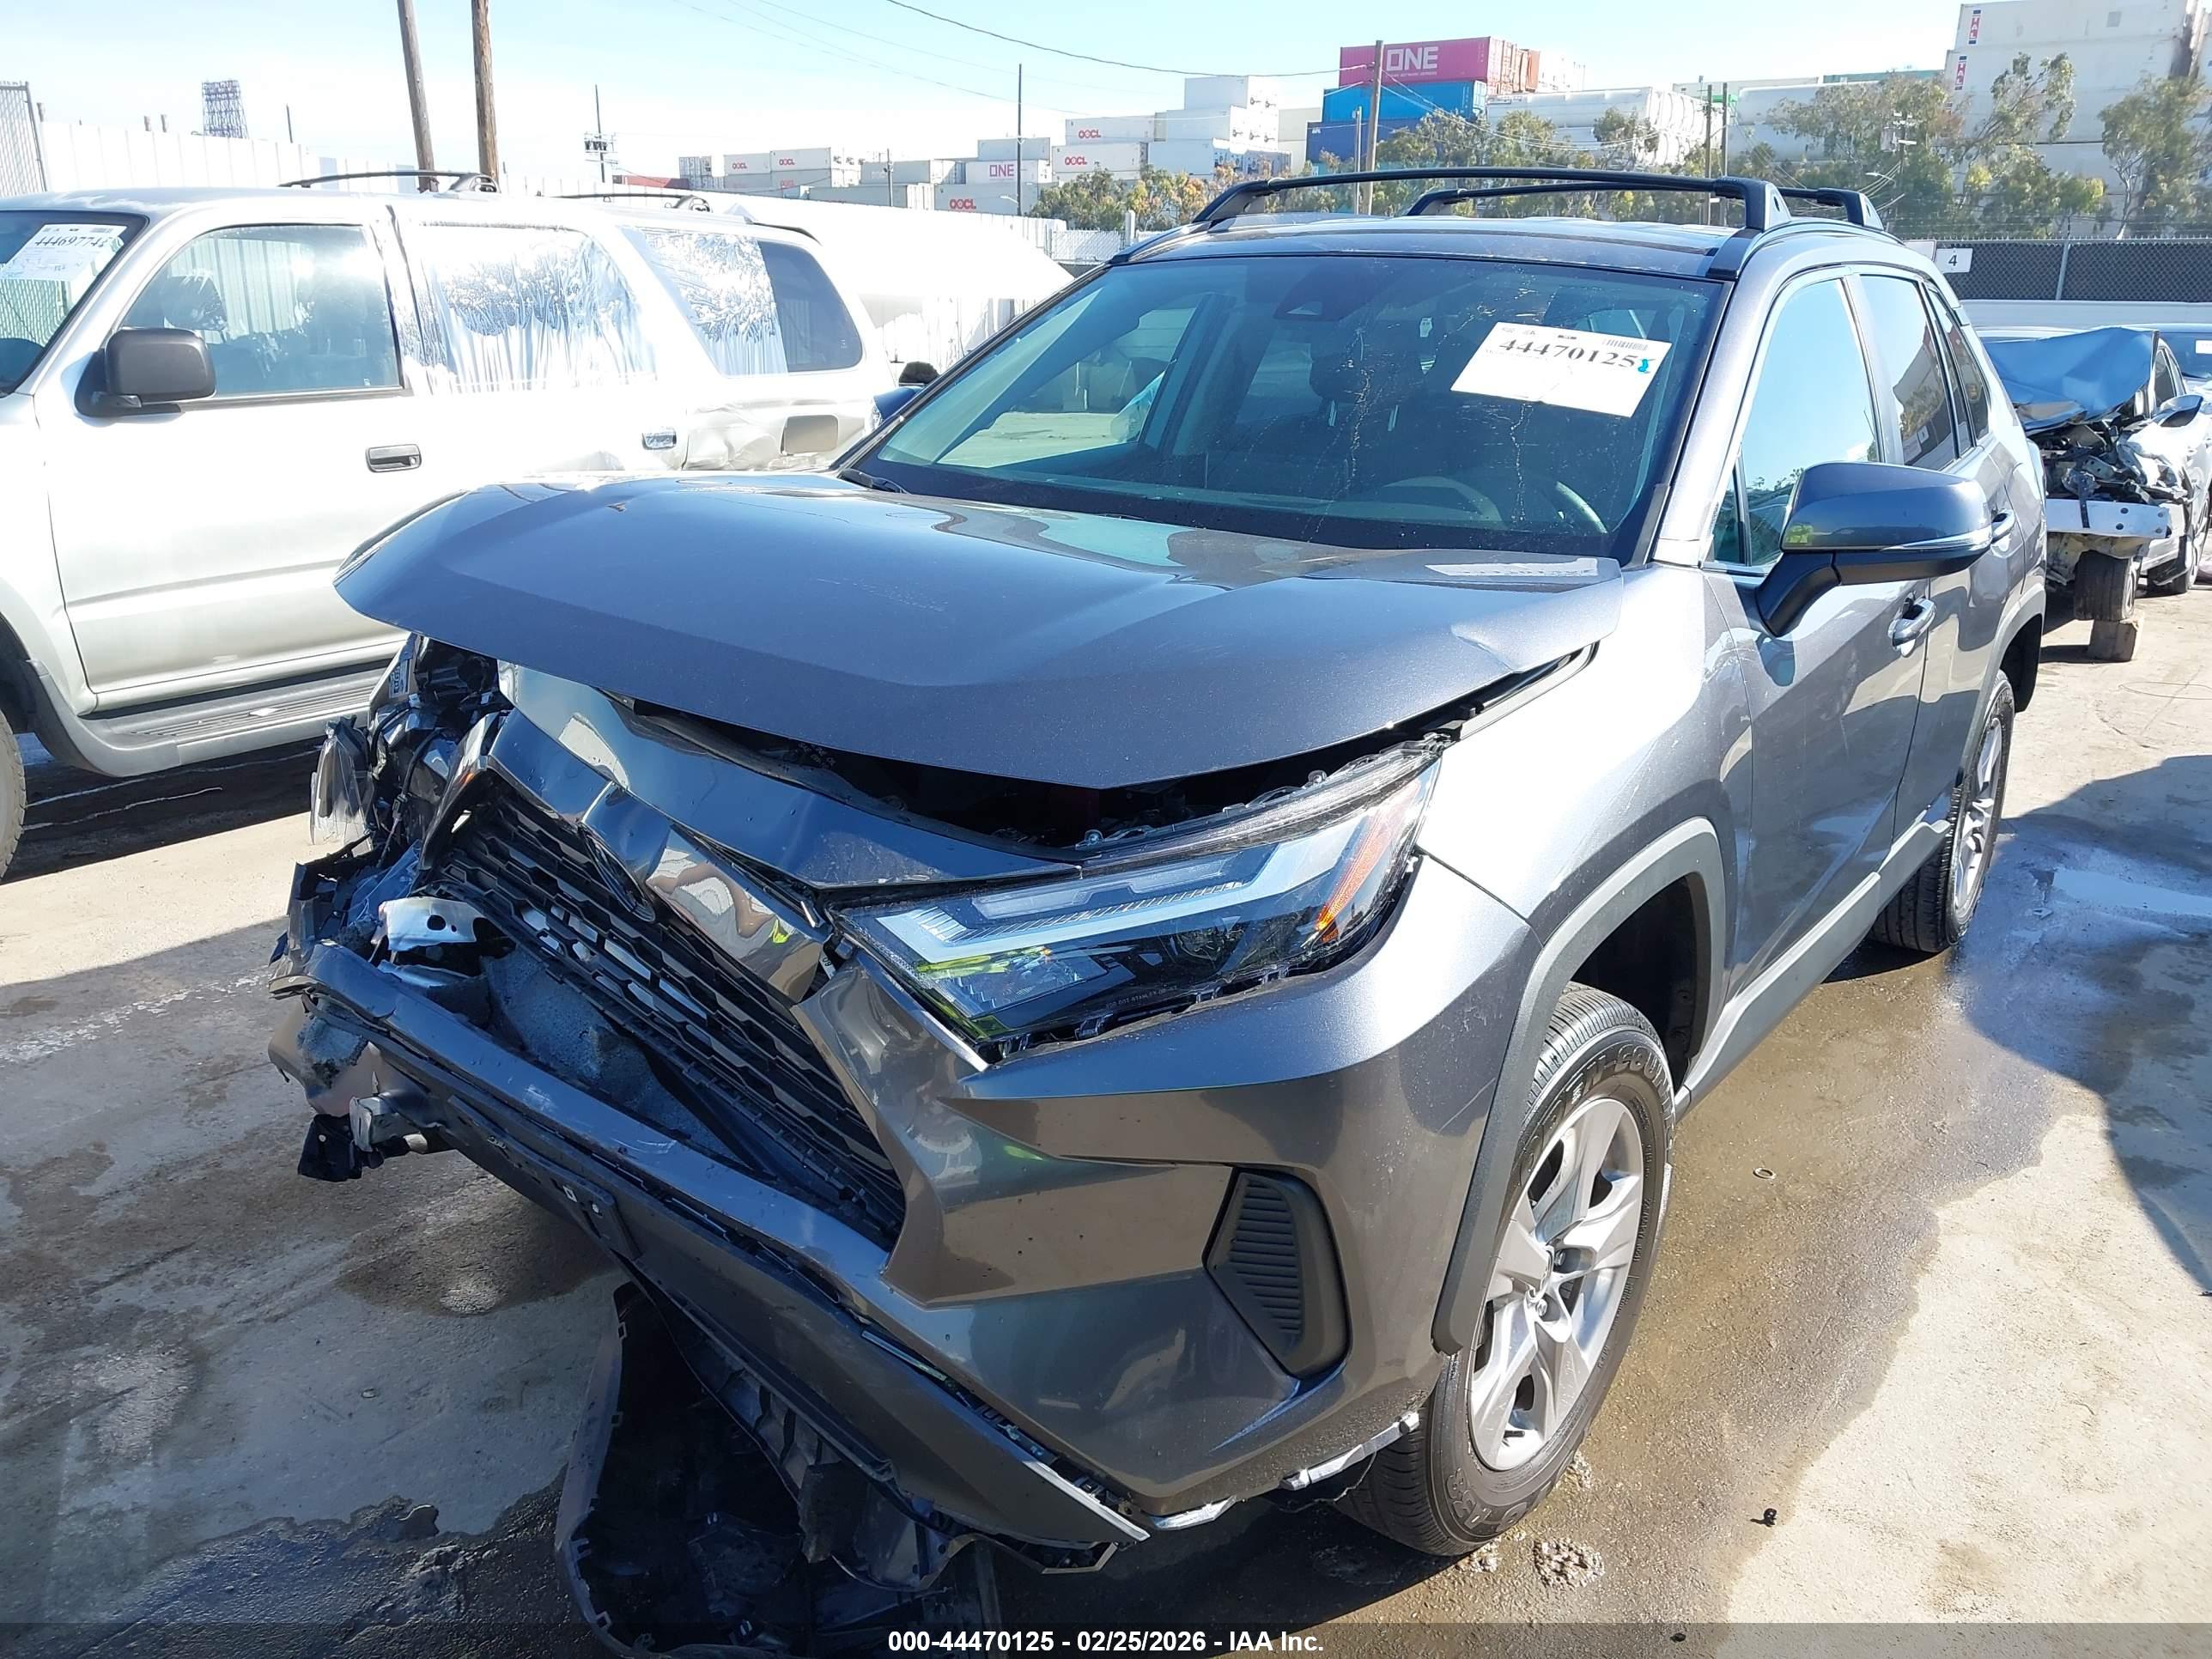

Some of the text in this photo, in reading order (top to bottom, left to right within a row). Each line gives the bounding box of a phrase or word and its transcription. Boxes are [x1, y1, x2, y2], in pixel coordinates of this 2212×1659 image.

[1386, 46, 1439, 71] ONE
[1078, 129, 1102, 138] OOCL
[1065, 156, 1087, 165] OOCL
[989, 164, 1015, 177] ONE
[949, 198, 976, 210] OOCL
[1948, 254, 1958, 266] 4
